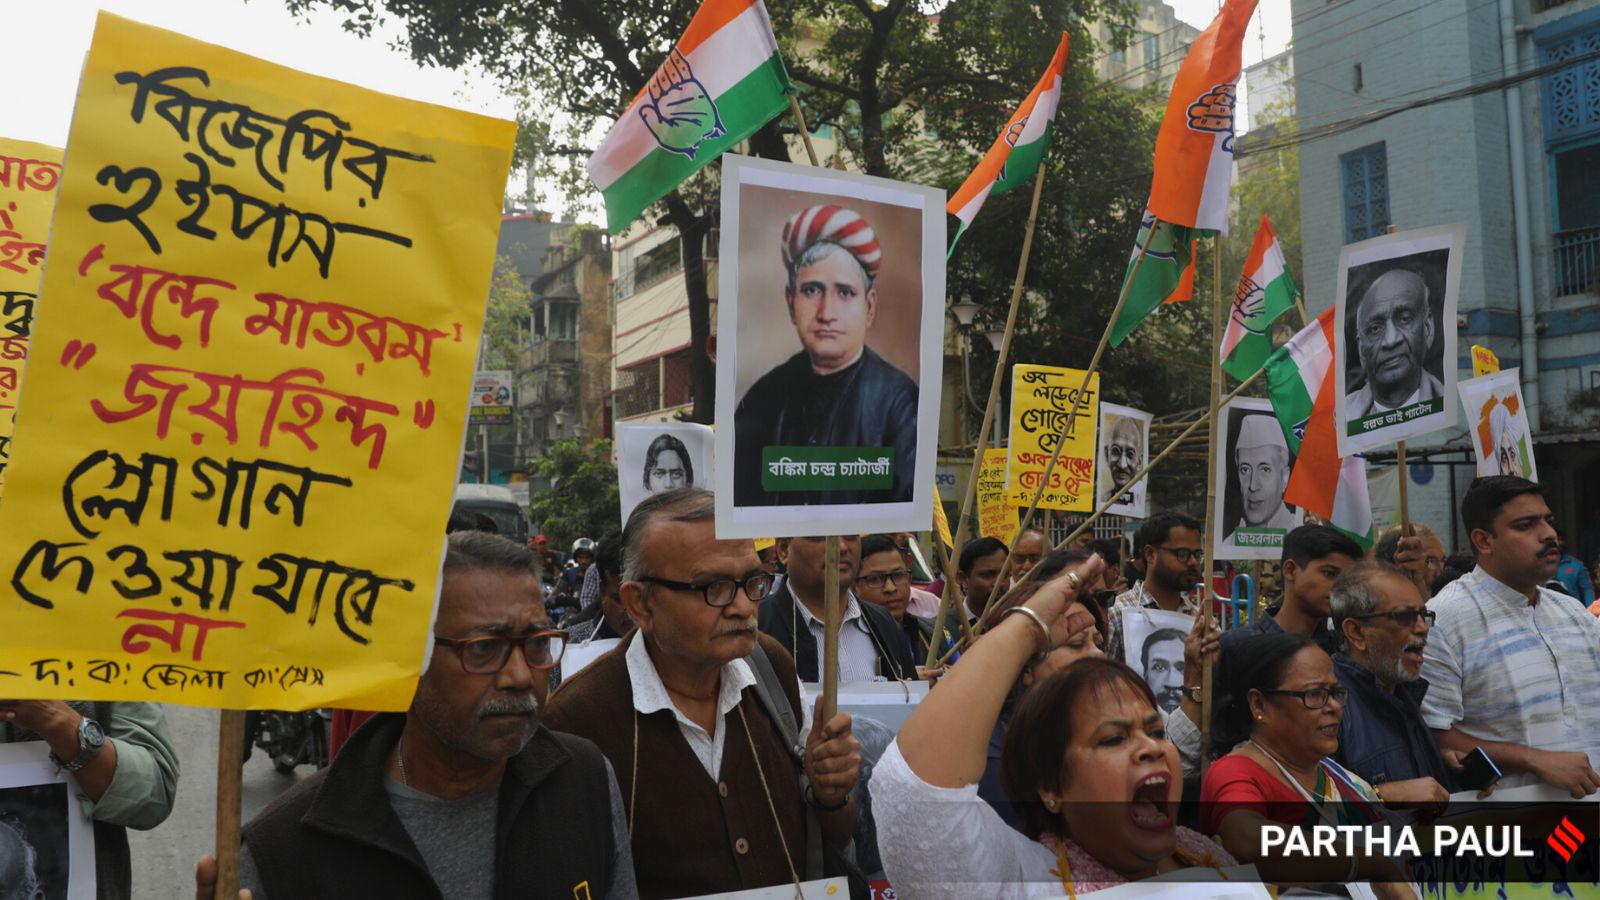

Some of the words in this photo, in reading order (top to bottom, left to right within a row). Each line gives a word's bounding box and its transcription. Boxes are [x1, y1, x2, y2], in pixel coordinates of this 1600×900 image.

[115, 66, 436, 207] বিজেপির
[1385, 409, 1404, 424] ভাই
[768, 457, 807, 477] বঙ্কিম
[809, 462, 837, 477] চন্দ্র
[1236, 532, 1285, 545] জহরলাল
[116, 608, 246, 662] না
